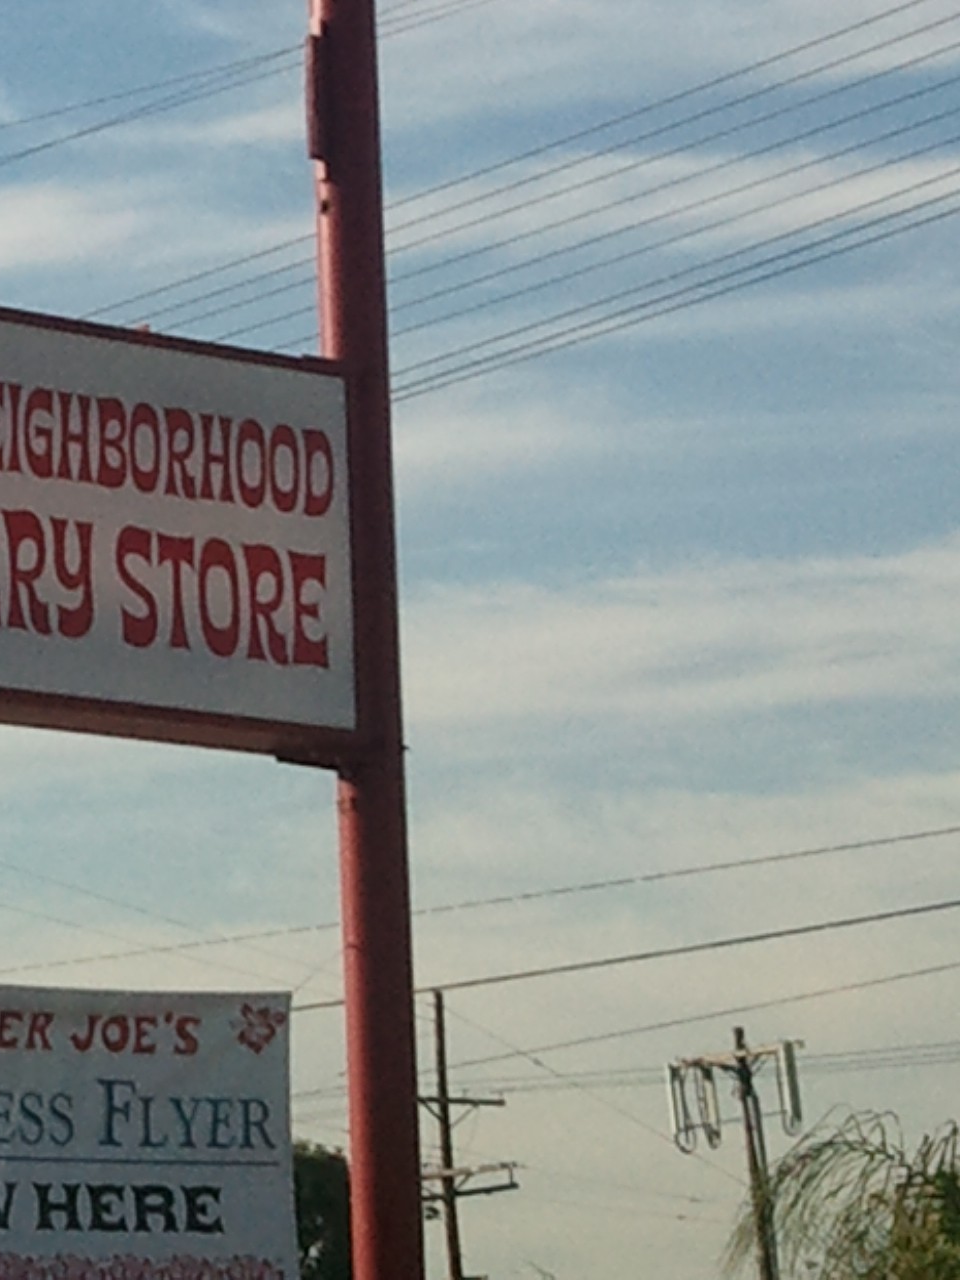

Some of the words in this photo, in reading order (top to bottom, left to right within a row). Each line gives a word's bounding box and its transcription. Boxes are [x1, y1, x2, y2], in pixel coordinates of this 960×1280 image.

[115, 524, 330, 669] STORE
[70, 1011, 202, 1056] JOE'S
[97, 1078, 277, 1151] FLYER
[33, 1182, 224, 1235] HERE
